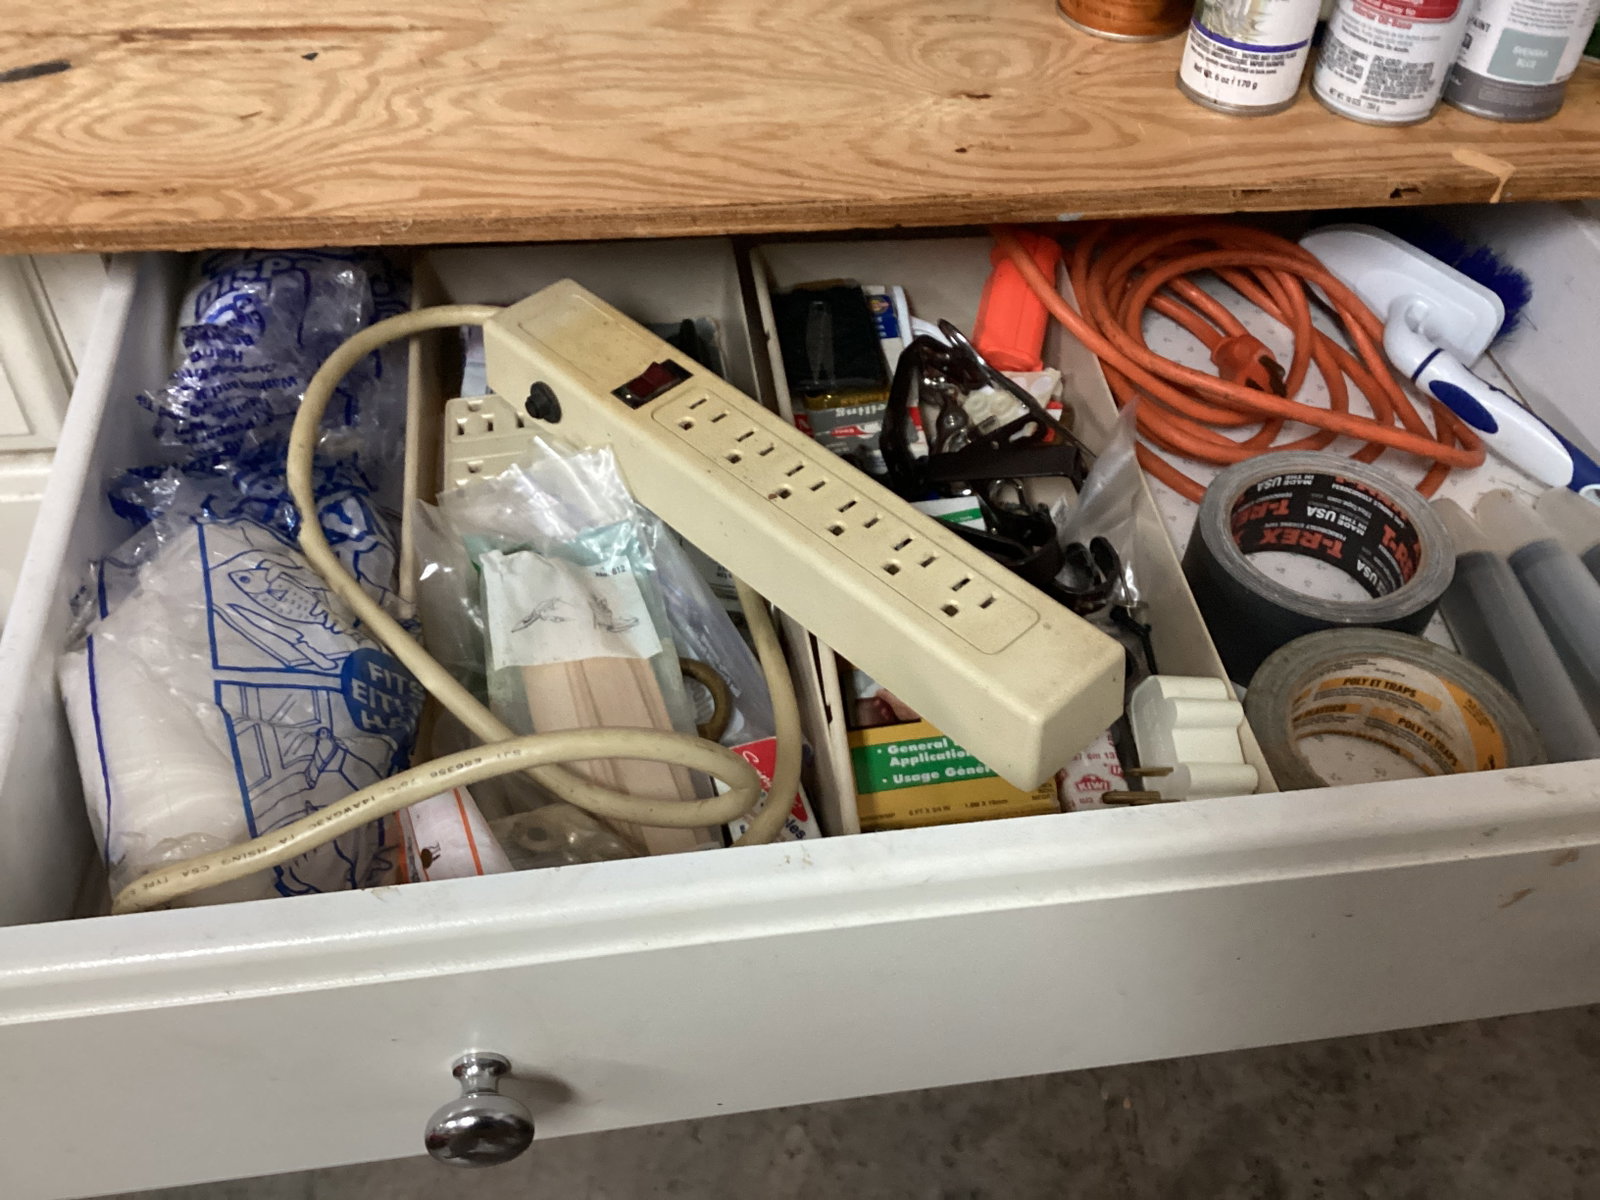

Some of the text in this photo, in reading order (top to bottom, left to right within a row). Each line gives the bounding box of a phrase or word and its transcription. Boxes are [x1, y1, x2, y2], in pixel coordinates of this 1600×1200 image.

[1306, 505, 1337, 523] USA
[1260, 528, 1343, 559] T-REX
[1356, 559, 1378, 586] USA
[887, 737, 949, 756] General
[892, 769, 941, 786] Usage
